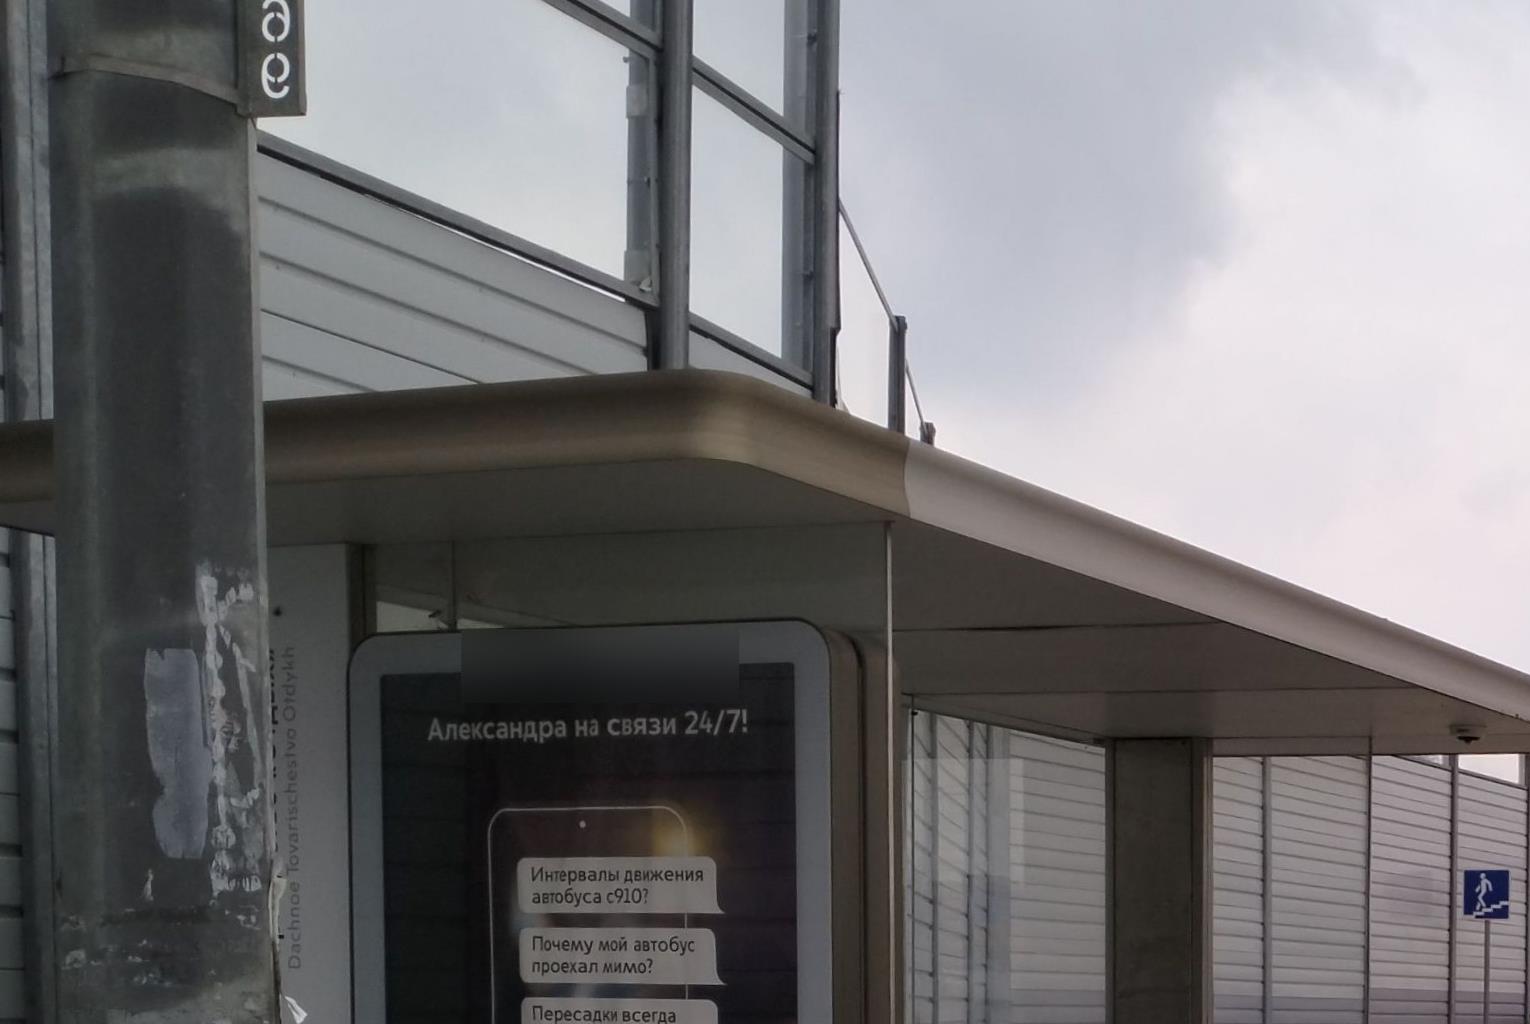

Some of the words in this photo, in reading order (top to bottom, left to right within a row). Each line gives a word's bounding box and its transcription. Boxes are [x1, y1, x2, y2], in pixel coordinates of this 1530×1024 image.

[281, 647, 300, 722] Otdykh
[427, 713, 567, 743] Александра
[574, 718, 600, 738] на
[607, 717, 676, 737] связи
[684, 708, 749, 737] 24/7!
[283, 729, 302, 874] Tovarischestvo
[530, 866, 620, 885] Интервалы
[623, 868, 704, 884] движения
[531, 888, 602, 907] автобуса
[606, 888, 649, 904] с910?
[284, 881, 302, 969] Dachnoe
[531, 935, 593, 955] Почему
[598, 936, 628, 952] мой
[633, 935, 696, 956] автобус
[531, 960, 599, 976] проехал
[602, 958, 653, 974] мимо?
[531, 1005, 618, 1024] Пересадки
[622, 1009, 677, 1024] всегда
